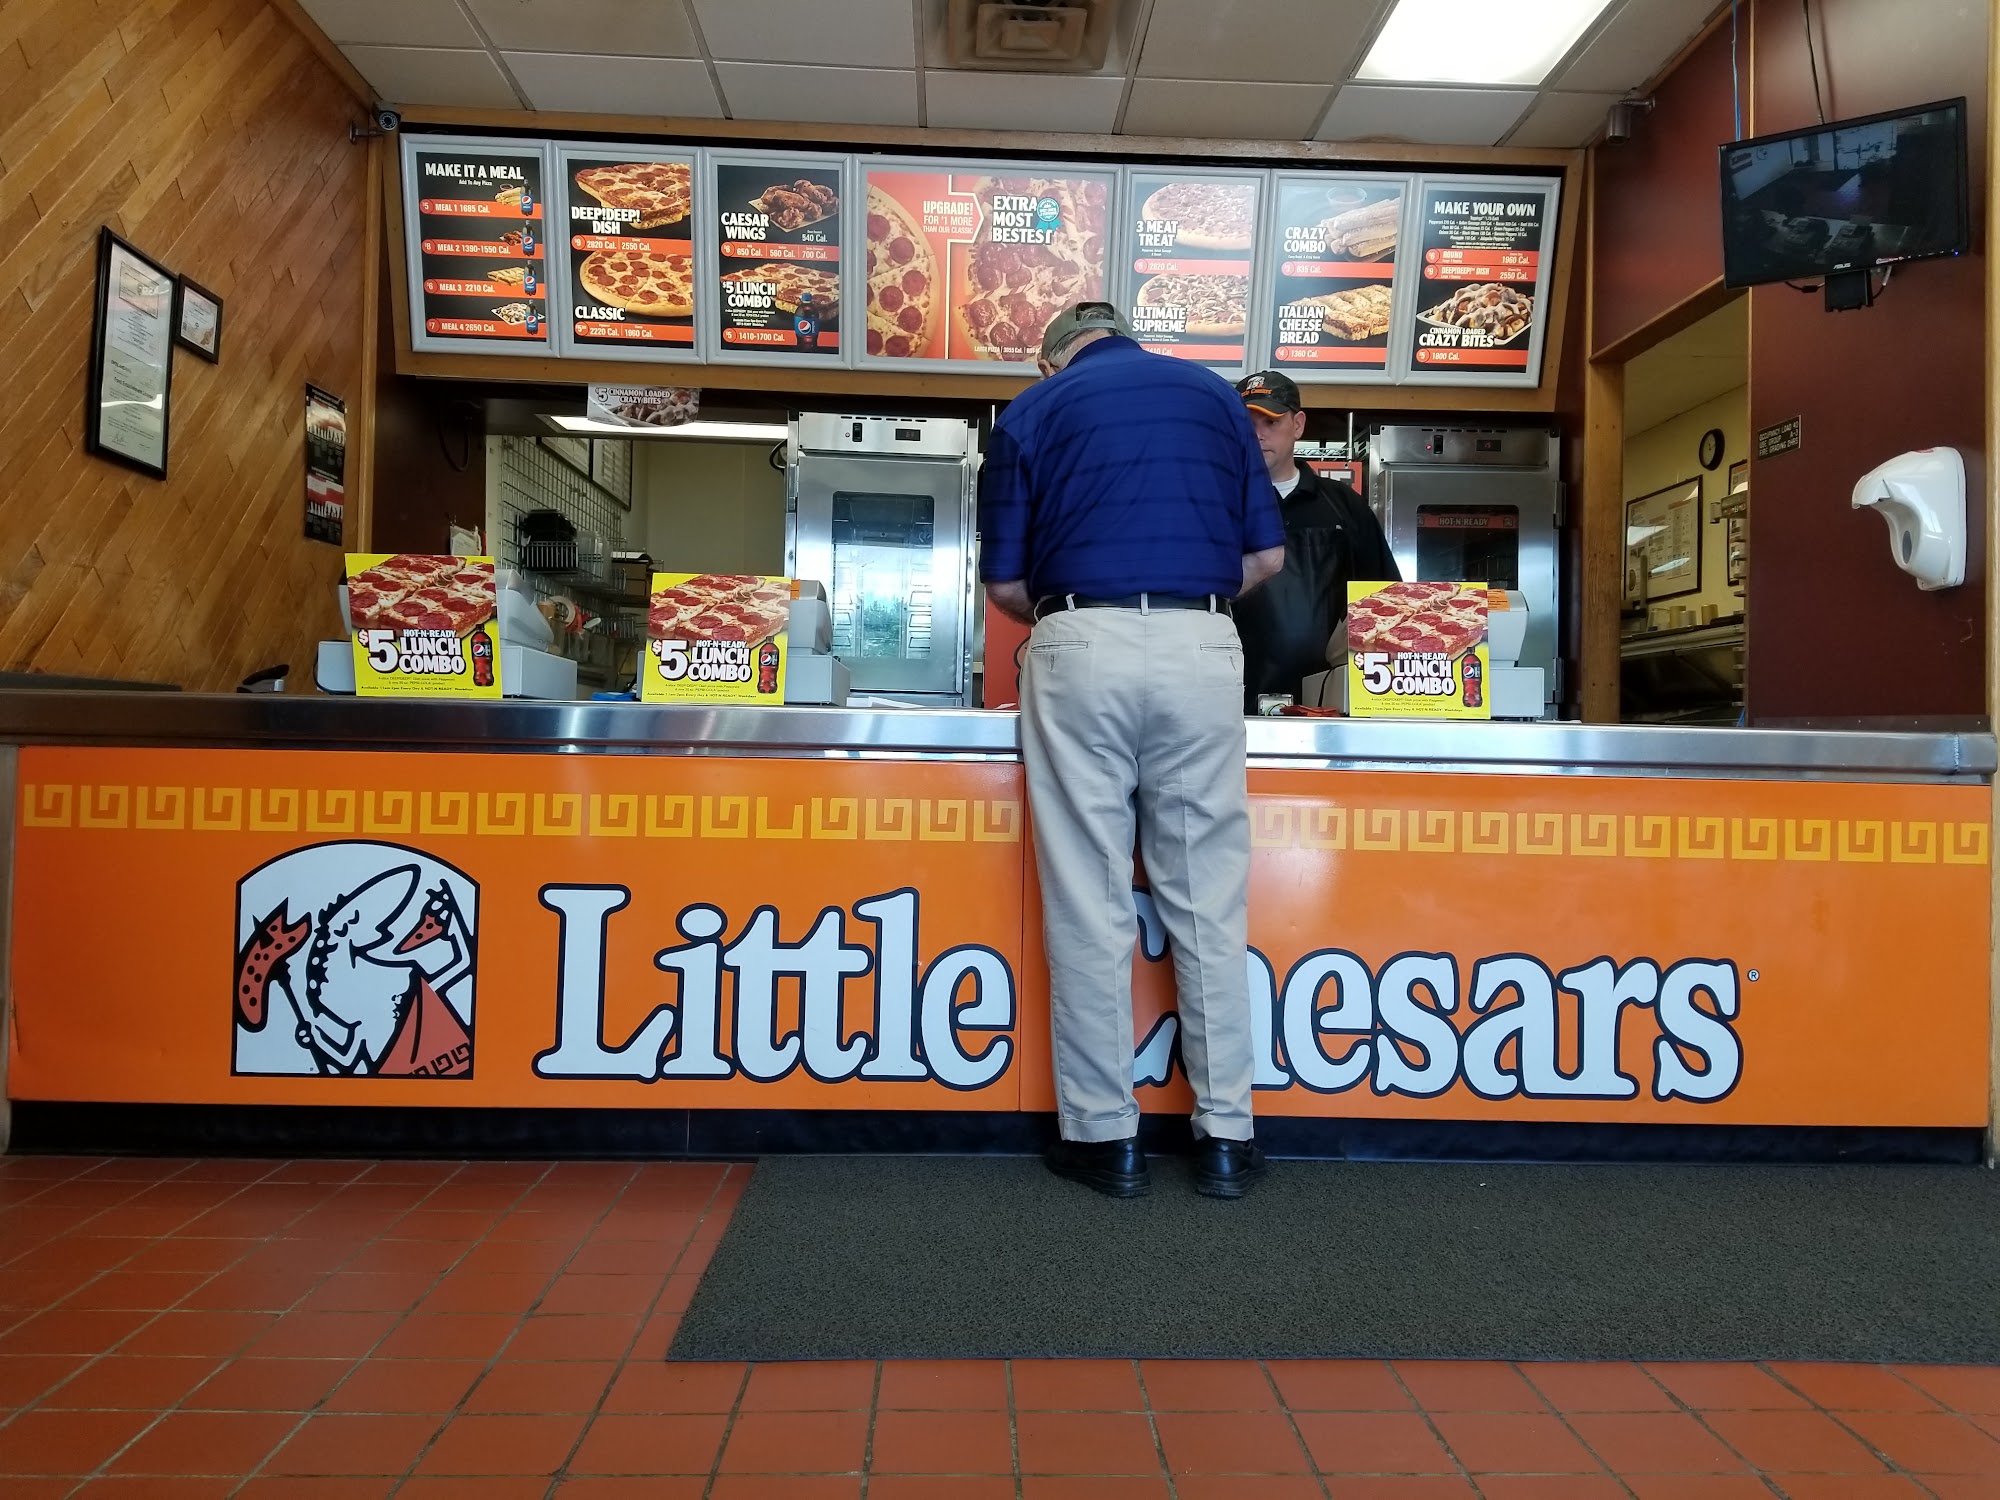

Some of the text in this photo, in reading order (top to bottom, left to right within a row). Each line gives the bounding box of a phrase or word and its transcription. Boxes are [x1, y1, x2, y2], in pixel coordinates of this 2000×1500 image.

[425, 163, 524, 179] MAKE IT A MEAL
[435, 203, 453, 212] MEAL
[477, 205, 490, 213] Cal.
[923, 200, 974, 215] UPGRADE!
[993, 195, 1037, 212] EXTRA
[1434, 201, 1536, 217] MAKE YOUR OWN
[571, 206, 641, 223] DEEP!DEEP!
[720, 212, 770, 227] CAESAR
[923, 215, 939, 225] FOR
[950, 216, 973, 227] MORE
[993, 211, 1033, 227] MOST
[592, 221, 621, 235] DISH
[725, 225, 767, 241] WINGS
[938, 226, 950, 234] OUR
[951, 227, 974, 235] CLASSIC
[1136, 220, 1179, 234] 3 MEAT
[1285, 227, 1327, 240] CRAZY
[815, 234, 828, 243] Cal.
[1139, 233, 1176, 247] TREAT
[437, 243, 455, 252] MEAL
[455, 244, 460, 252] 2
[498, 246, 511, 254] Cal.
[604, 241, 617, 250] Cal.
[621, 241, 651, 251] 2550 Cal.
[750, 247, 763, 257] Cal.
[1284, 240, 1326, 253] COMBO
[783, 249, 796, 258] Cal.
[802, 250, 828, 259] 700 Cal.
[1442, 251, 1463, 259] ROUND
[1518, 256, 1530, 264] Cal.
[1166, 263, 1178, 272] Cal.
[1310, 266, 1322, 274] Cal.
[1517, 272, 1528, 280] Cal.
[439, 283, 457, 292] MEAL
[457, 284, 462, 292] 3
[465, 284, 482, 292] 2210
[482, 284, 495, 293] Cal.
[722, 281, 776, 296] $5 LUNCH
[727, 294, 772, 309] COMBO
[575, 306, 626, 321] CLASSIC
[1133, 306, 1187, 320] ULTIMATE
[1278, 305, 1325, 319] ITALIAN
[441, 322, 459, 331] MEAL
[459, 323, 464, 331] 4
[465, 323, 482, 332] 2650
[483, 323, 496, 332] Cal.
[590, 327, 607, 336] 2220
[607, 327, 620, 337] Cal.
[1132, 320, 1186, 333] SUPREME
[1279, 319, 1322, 332] CHEESE
[1430, 327, 1461, 335] CINNAMON
[641, 329, 654, 338] Cal.
[773, 333, 785, 342] Cal.
[1280, 331, 1320, 344] BREAD
[1419, 334, 1494, 348] CRAZY BITES
[1307, 350, 1319, 358] Cal.
[1448, 352, 1460, 361] Cal.
[609, 389, 643, 398] CINNAMON
[645, 390, 670, 398] LOADED
[643, 397, 661, 405] BITES
[1439, 518, 1488, 526] HOT-N-READY
[358, 629, 456, 672] $5 HOT-N-READY
[400, 637, 461, 656] LUNCH
[652, 639, 746, 679] $5 HOT-N-READY
[691, 647, 750, 665] LUNCH
[399, 655, 466, 674] COMBO
[1394, 660, 1452, 677] LUNCH
[688, 664, 751, 681] COMBO
[1354, 652, 1448, 694] $5 HOT-N-READY
[1392, 677, 1456, 695] COMBO
[532, 883, 1742, 1104] Little esars
